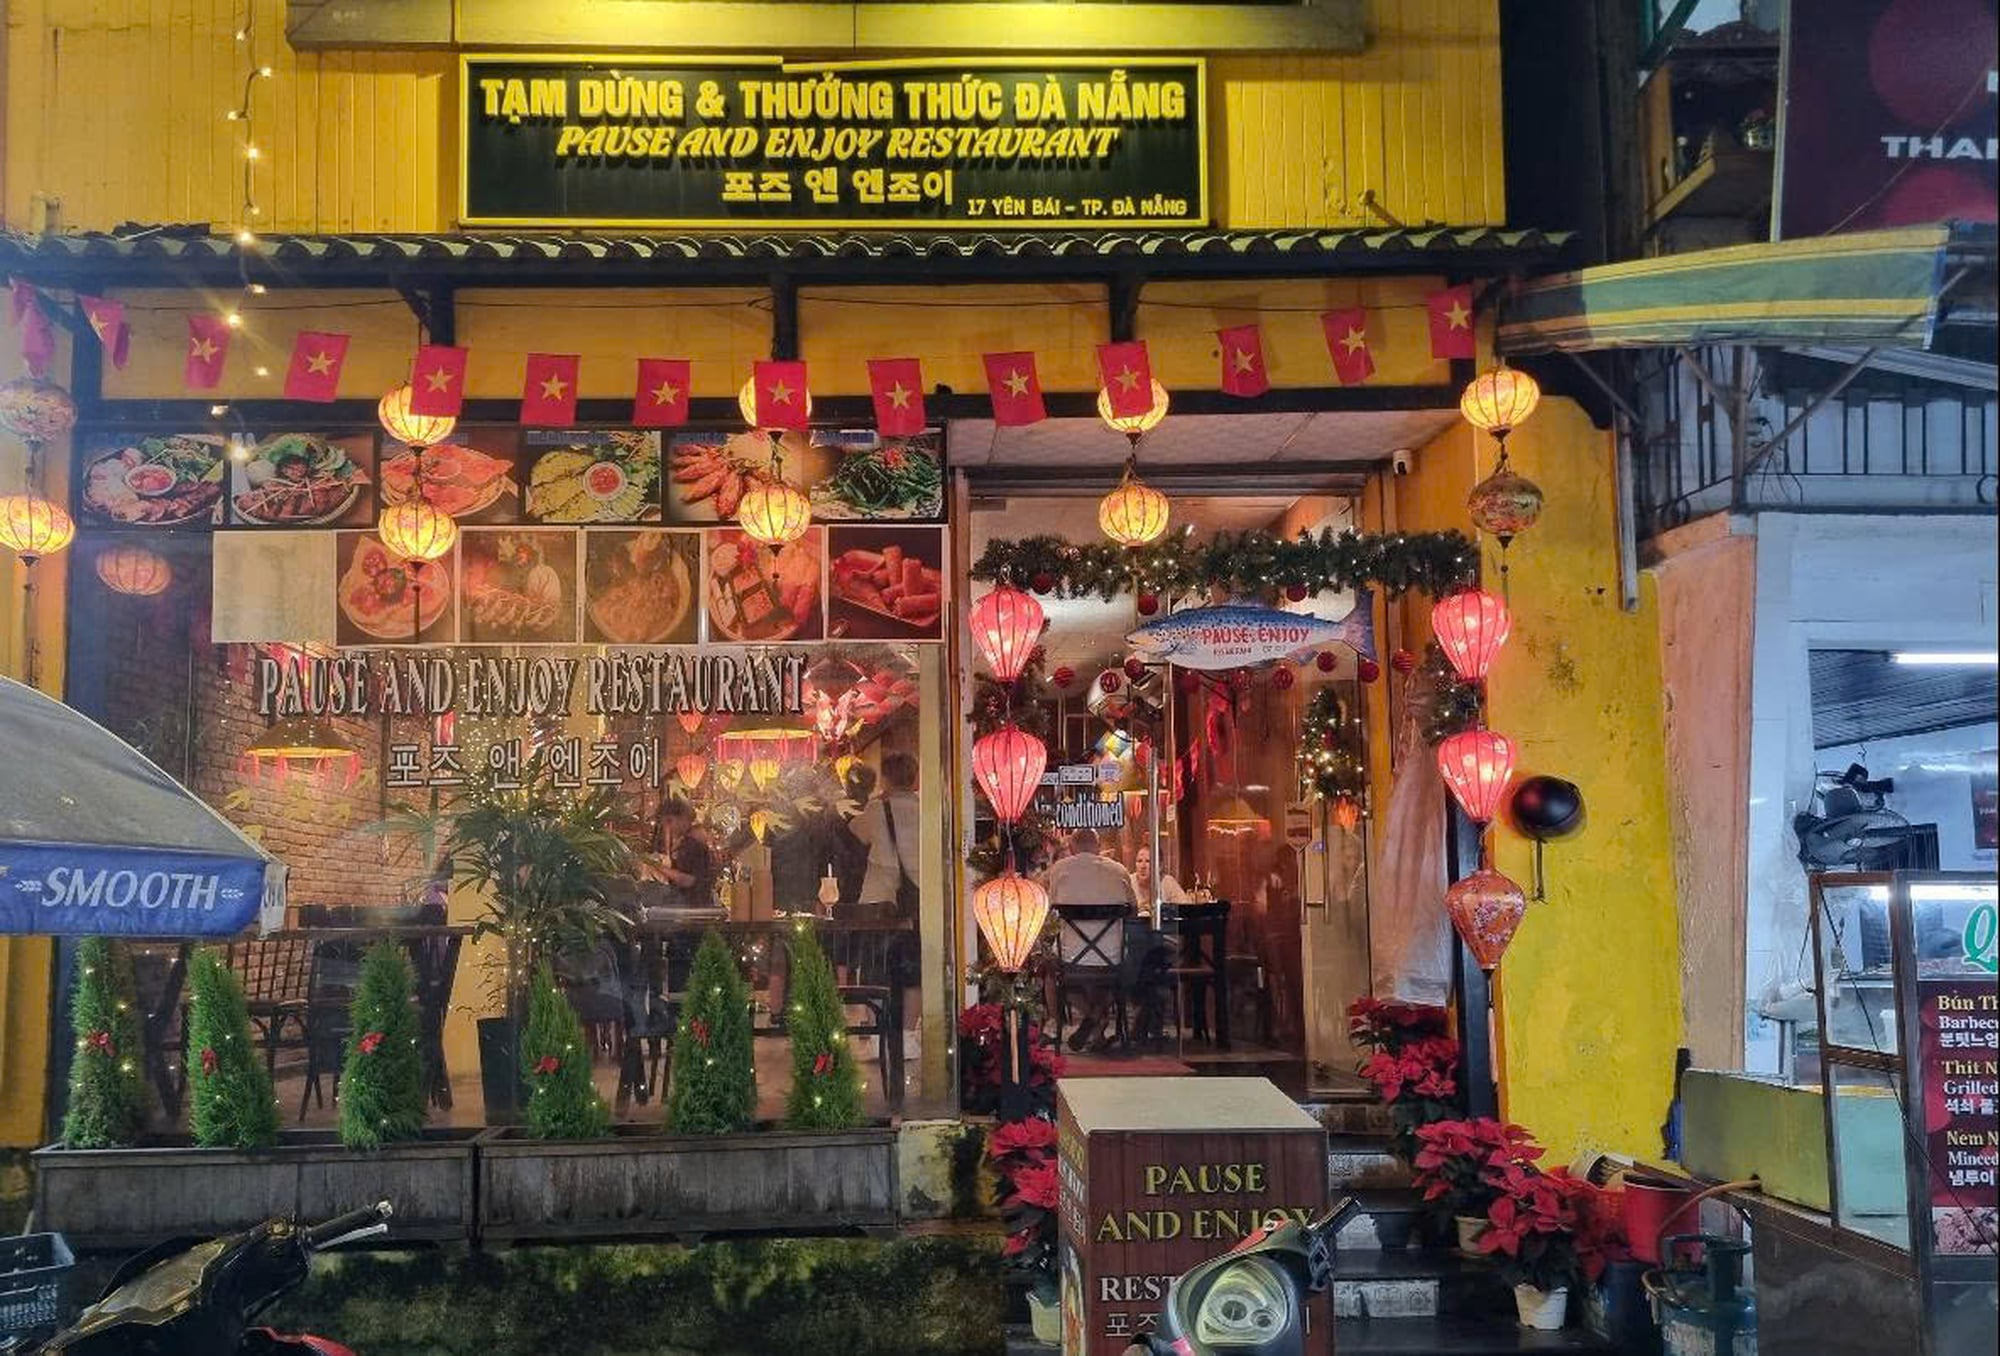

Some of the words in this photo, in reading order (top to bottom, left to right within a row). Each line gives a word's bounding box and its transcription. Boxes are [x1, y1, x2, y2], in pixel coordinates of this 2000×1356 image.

[480, 79, 567, 123] TẠM
[578, 69, 685, 118] DỪNG
[695, 80, 725, 118] &
[738, 72, 894, 118] THƯỞNG
[903, 73, 1003, 119] THỨC
[1013, 73, 1067, 119] ĐÀ
[556, 126, 676, 157] PAUSE
[676, 127, 759, 157] AND
[764, 127, 884, 161] ENJOY
[886, 126, 1121, 158] RESTAURANT
[722, 172, 792, 201] 포즈
[852, 168, 953, 205] 엔조이
[967, 198, 987, 216] 17
[992, 195, 1026, 216] YÊN
[1031, 196, 1061, 216] BÁI
[1081, 198, 1108, 216] TP.
[1202, 627, 1249, 645] PAUSE
[1258, 627, 1309, 643] ENJOY
[258, 655, 369, 714] PAUSE
[379, 655, 452, 714] AND
[465, 655, 578, 715] ENJOY
[587, 654, 806, 714] RESTAURANT
[386, 744, 464, 788] 포즈
[488, 738, 522, 788] 앤
[549, 738, 659, 788] 엔조이
[41, 866, 220, 911] SMOOTH
[1937, 995, 1975, 1010] Bún
[1941, 1059, 1982, 1078] Thịt
[1943, 1080, 1998, 1095] Grilled
[1947, 1130, 1984, 1146] Nem
[1947, 1150, 1998, 1166] Minced
[1145, 1164, 1265, 1195] PAUSE
[1097, 1211, 1181, 1241] AND
